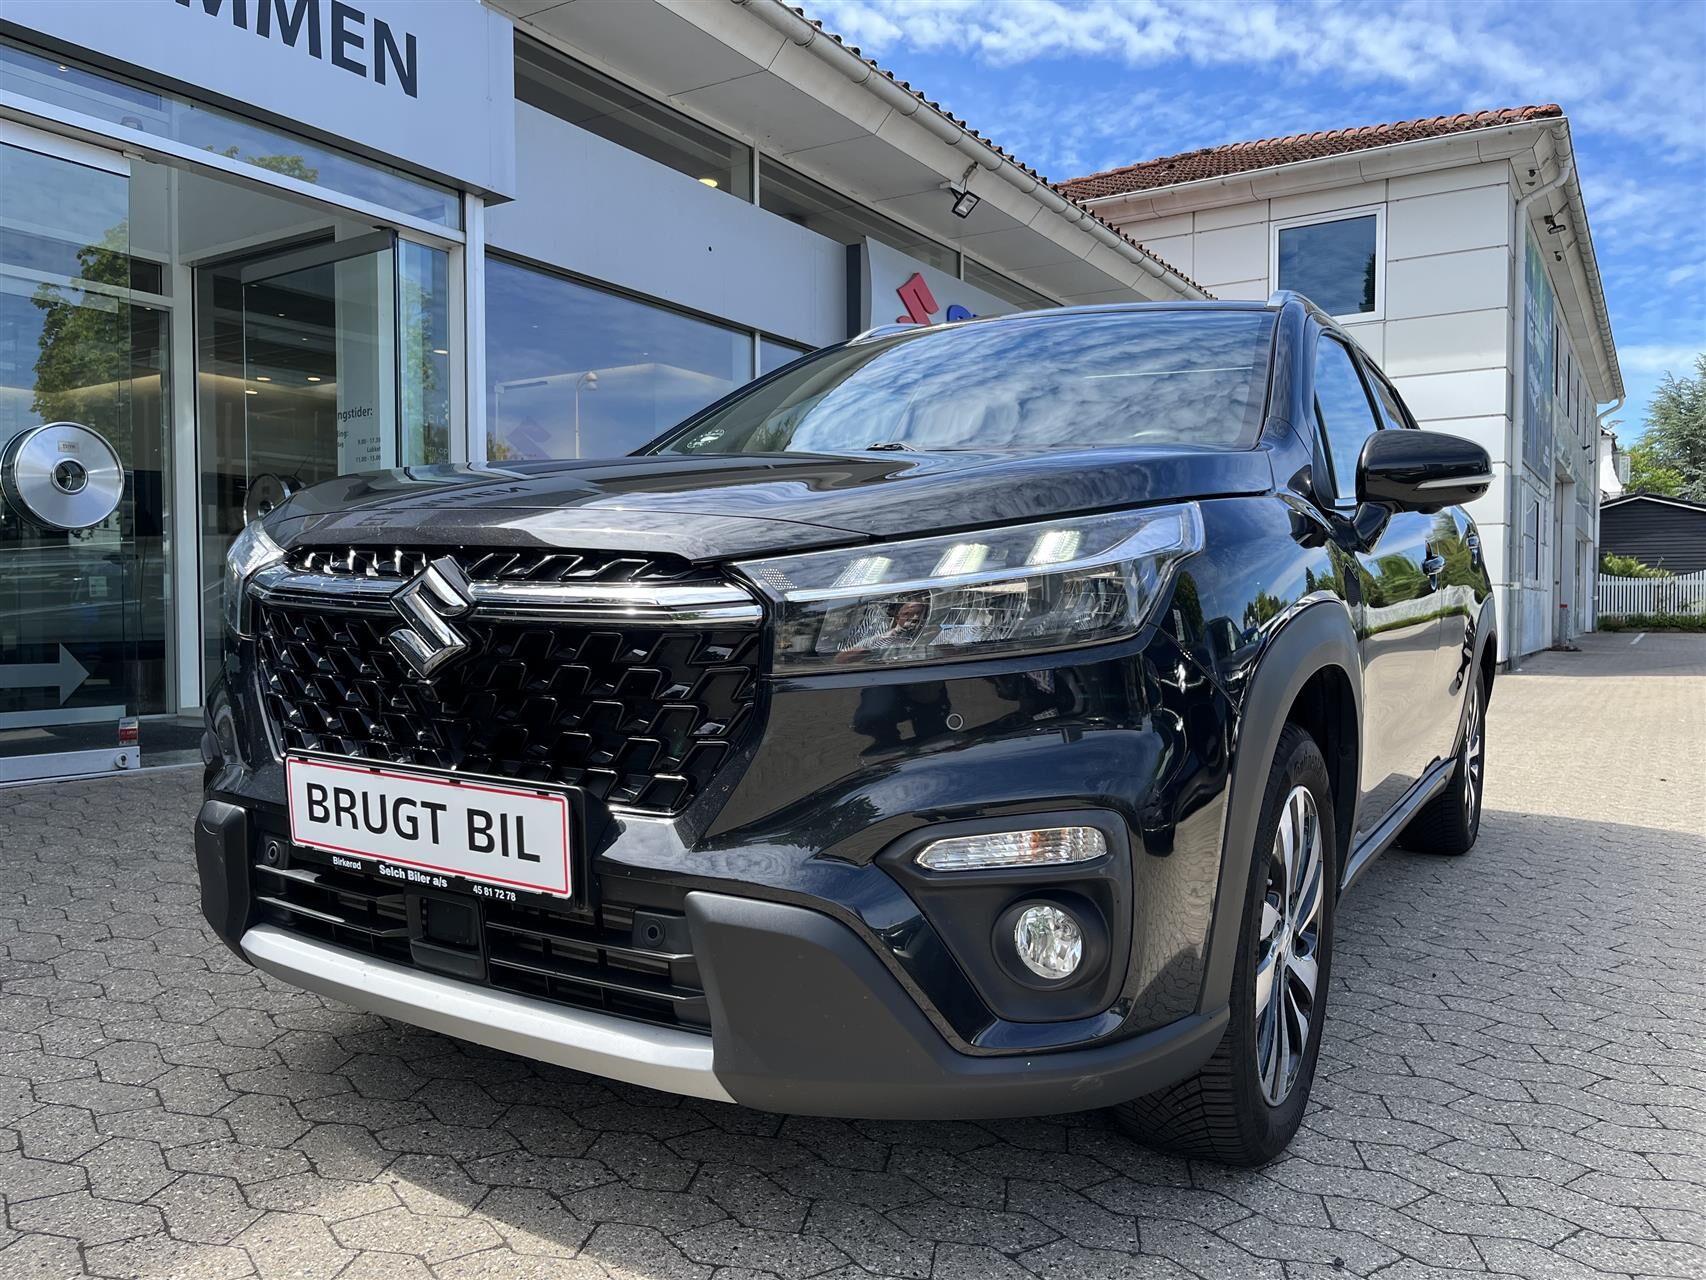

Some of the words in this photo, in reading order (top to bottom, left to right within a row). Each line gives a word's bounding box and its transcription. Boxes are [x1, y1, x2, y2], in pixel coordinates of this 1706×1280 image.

[306, 782, 447, 845] BRUGT
[466, 807, 541, 863] BIL
[379, 864, 406, 880] Selch
[407, 870, 431, 885] Biler
[433, 876, 448, 888] a/s
[472, 884, 482, 896] 45
[484, 886, 493, 897] 81
[494, 889, 505, 900] 72
[505, 891, 517, 901] 78
